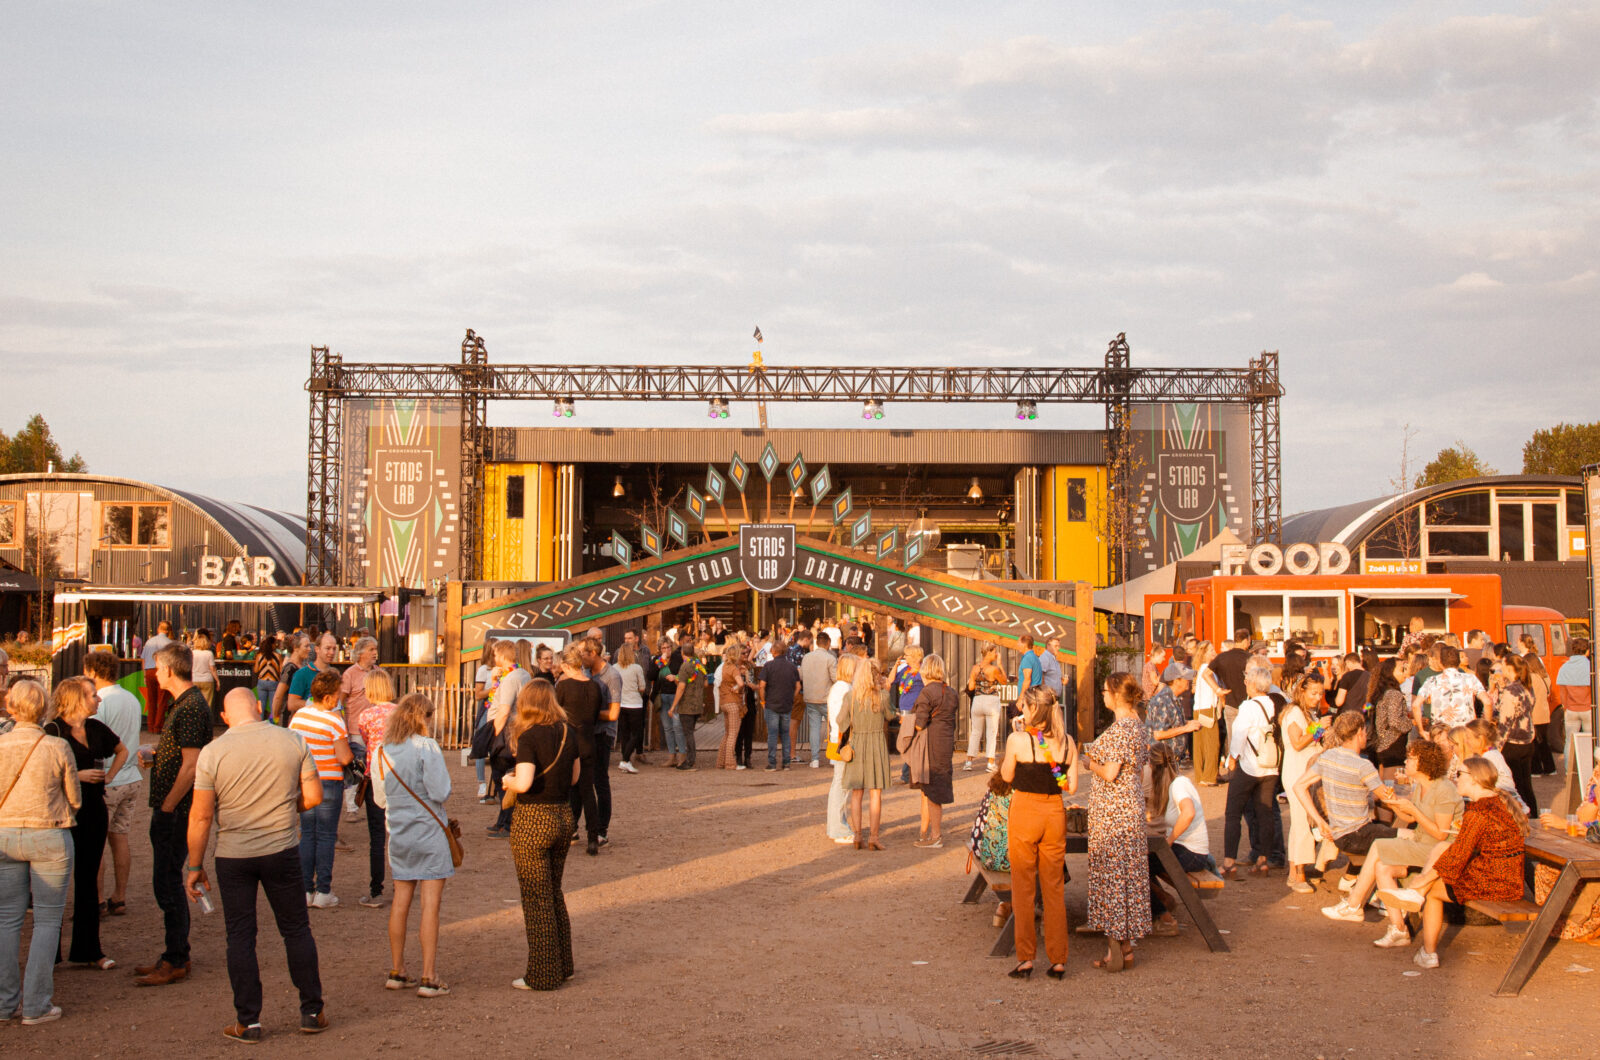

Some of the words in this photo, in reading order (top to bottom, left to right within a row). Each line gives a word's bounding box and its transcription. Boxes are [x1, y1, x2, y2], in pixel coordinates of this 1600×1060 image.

[385, 461, 423, 482] STADS
[1169, 465, 1206, 486] STADS
[394, 484, 415, 505] LAB
[1178, 488, 1199, 509] LAB
[750, 536, 785, 557] STADS
[758, 559, 778, 580] LAB
[1221, 542, 1351, 576] FOOD
[200, 555, 278, 586] BAR
[687, 556, 733, 585] FOOD
[804, 556, 874, 592] DRINKS
[217, 667, 251, 677] eineken
